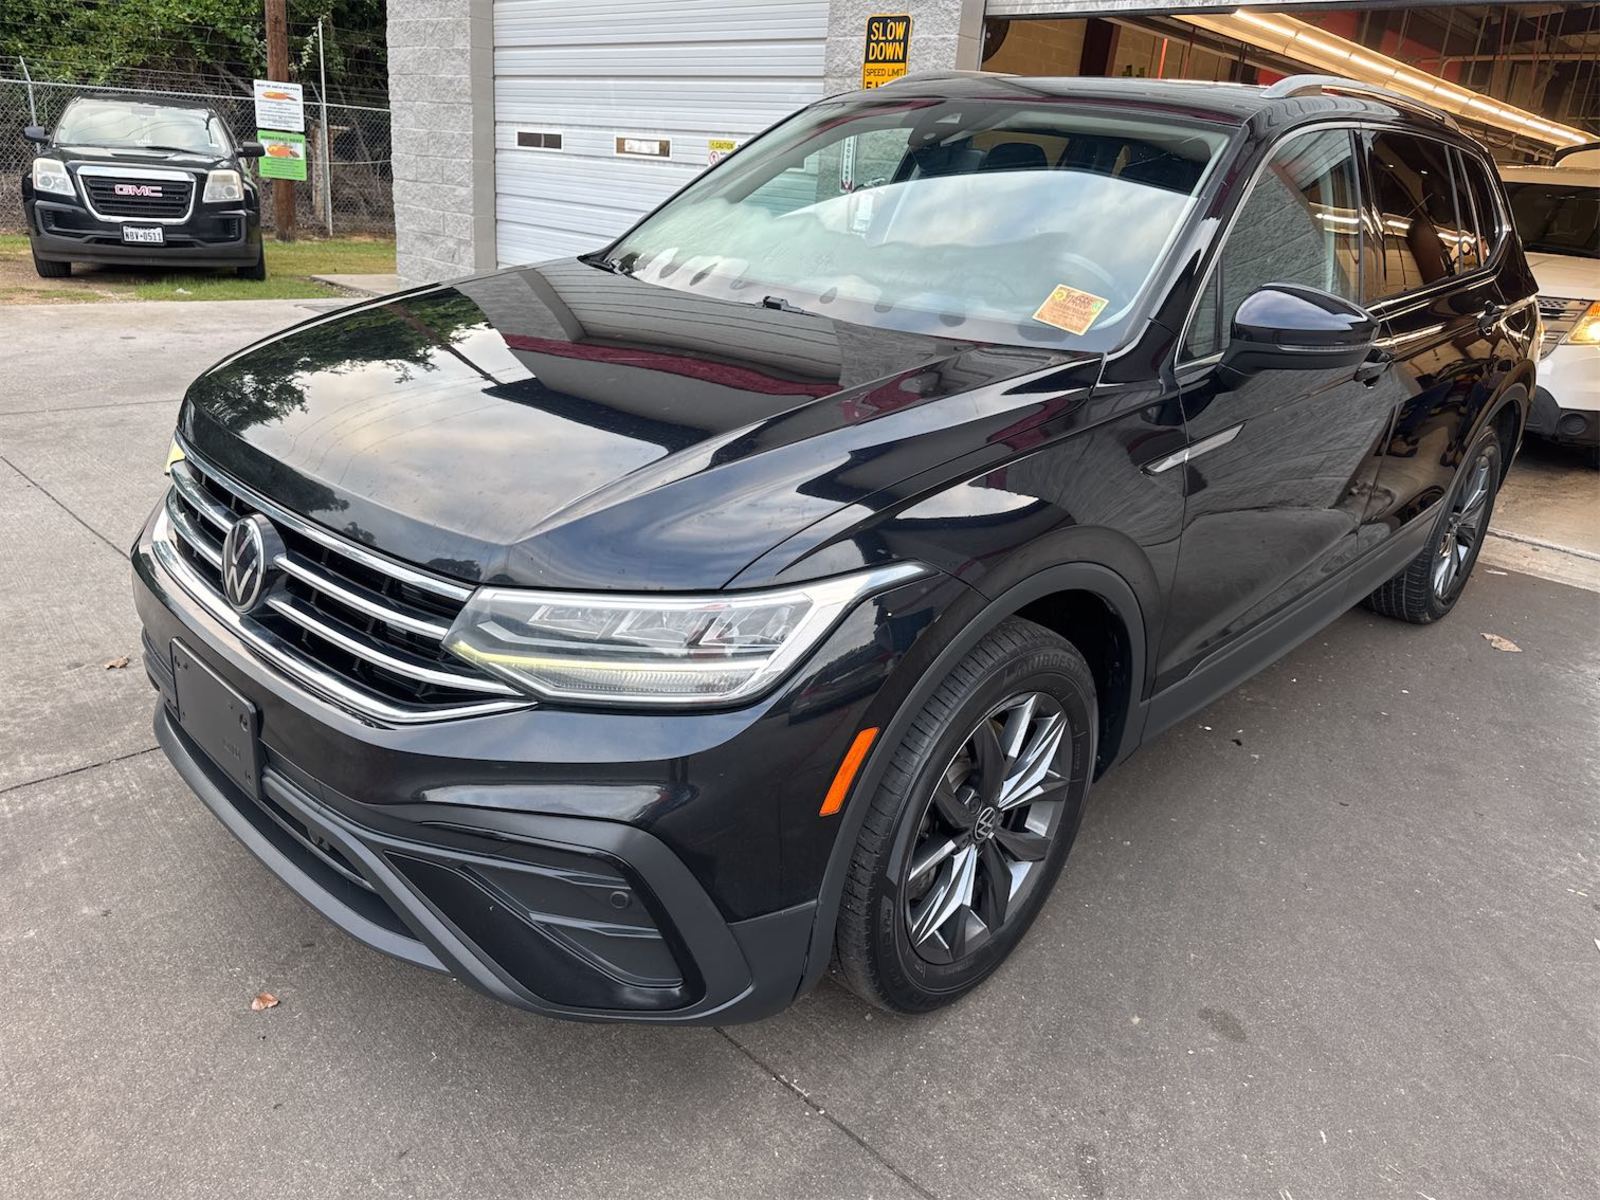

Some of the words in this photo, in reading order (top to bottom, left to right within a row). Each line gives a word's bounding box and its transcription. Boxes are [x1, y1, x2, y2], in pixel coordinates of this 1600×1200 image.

[870, 21, 906, 40] SLOW
[868, 42, 904, 60] DOWN
[866, 68, 886, 77] SPEED
[887, 68, 904, 77] LIMIT
[115, 184, 163, 198] GMC
